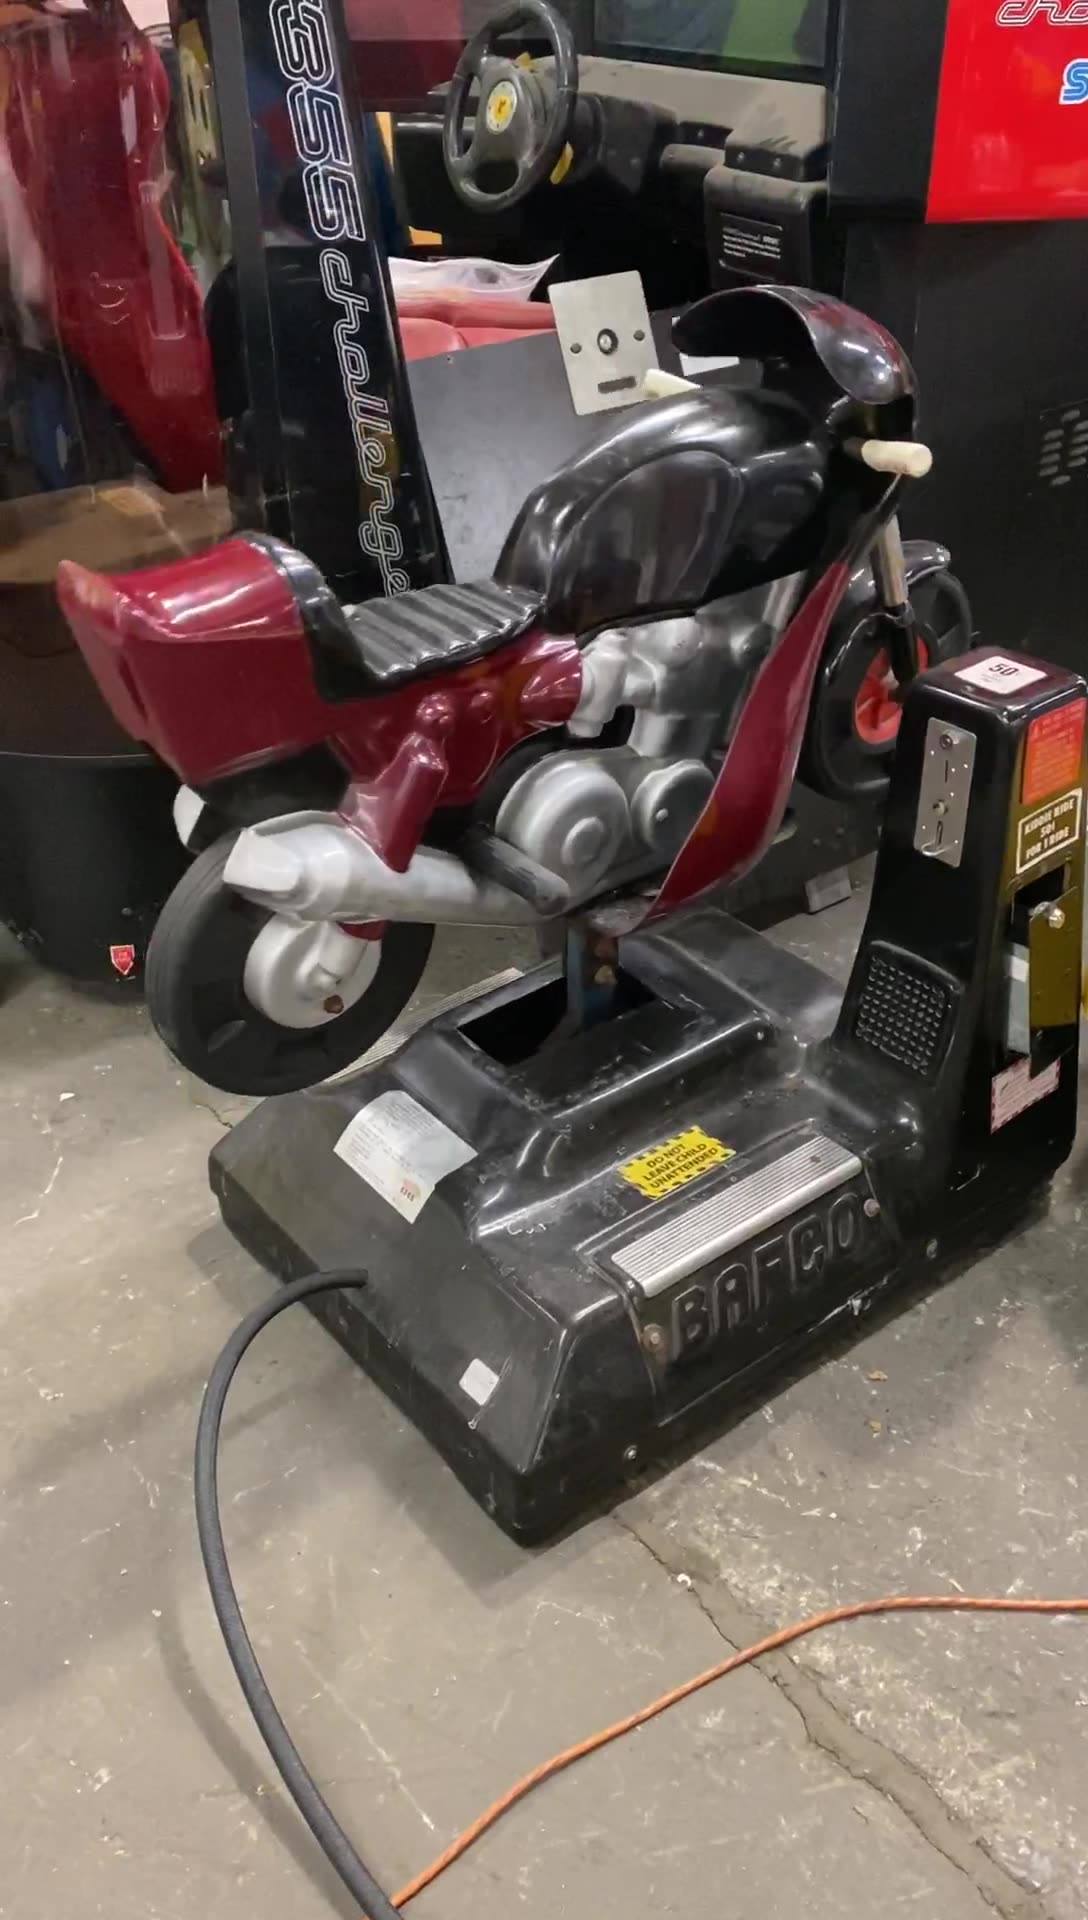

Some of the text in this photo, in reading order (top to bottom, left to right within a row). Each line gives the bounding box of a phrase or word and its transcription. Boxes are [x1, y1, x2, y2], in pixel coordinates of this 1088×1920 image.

[1053, 798, 1075, 818] RIDE
[1026, 841, 1042, 860] FOR
[1048, 826, 1070, 845] RIDE
[643, 1143, 707, 1181] LEAVE CHILD
[646, 1143, 686, 1168] DO NOT
[650, 1147, 718, 1189] UNATTENDED
[671, 1192, 864, 1362] BAFCO
